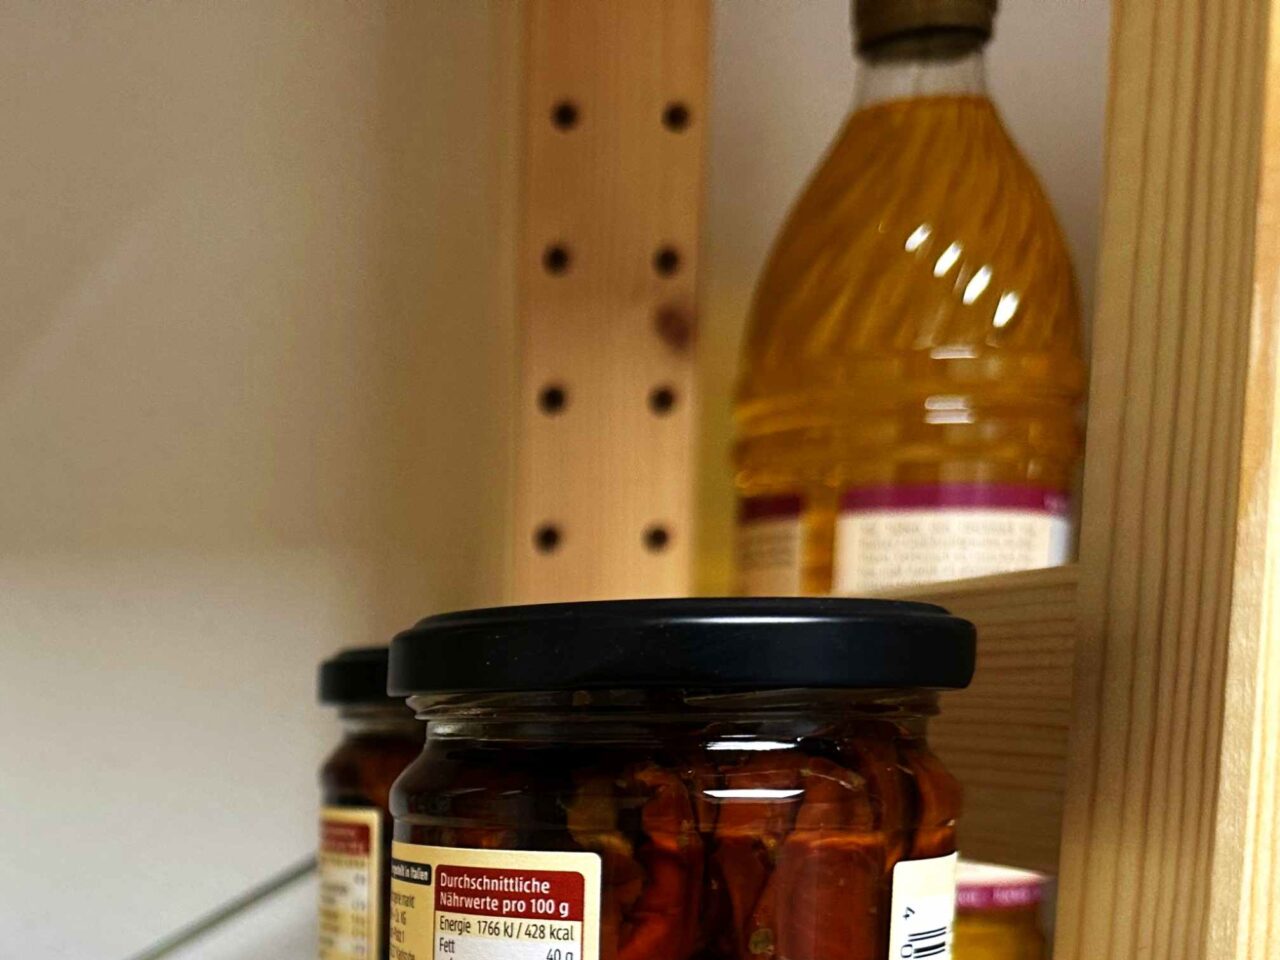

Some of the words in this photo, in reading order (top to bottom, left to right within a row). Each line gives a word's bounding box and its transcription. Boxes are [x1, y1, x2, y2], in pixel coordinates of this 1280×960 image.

[440, 872, 550, 893] Durchschnittliche
[439, 892, 498, 911] Nährwerte
[502, 900, 526, 914] pro
[530, 899, 555, 914] 100
[559, 902, 569, 917] g
[439, 915, 471, 935] Energie
[477, 920, 500, 936] 1766
[504, 921, 514, 938] kJ
[524, 923, 546, 939] 428
[549, 924, 574, 941] kcal
[439, 937, 455, 954] Fett
